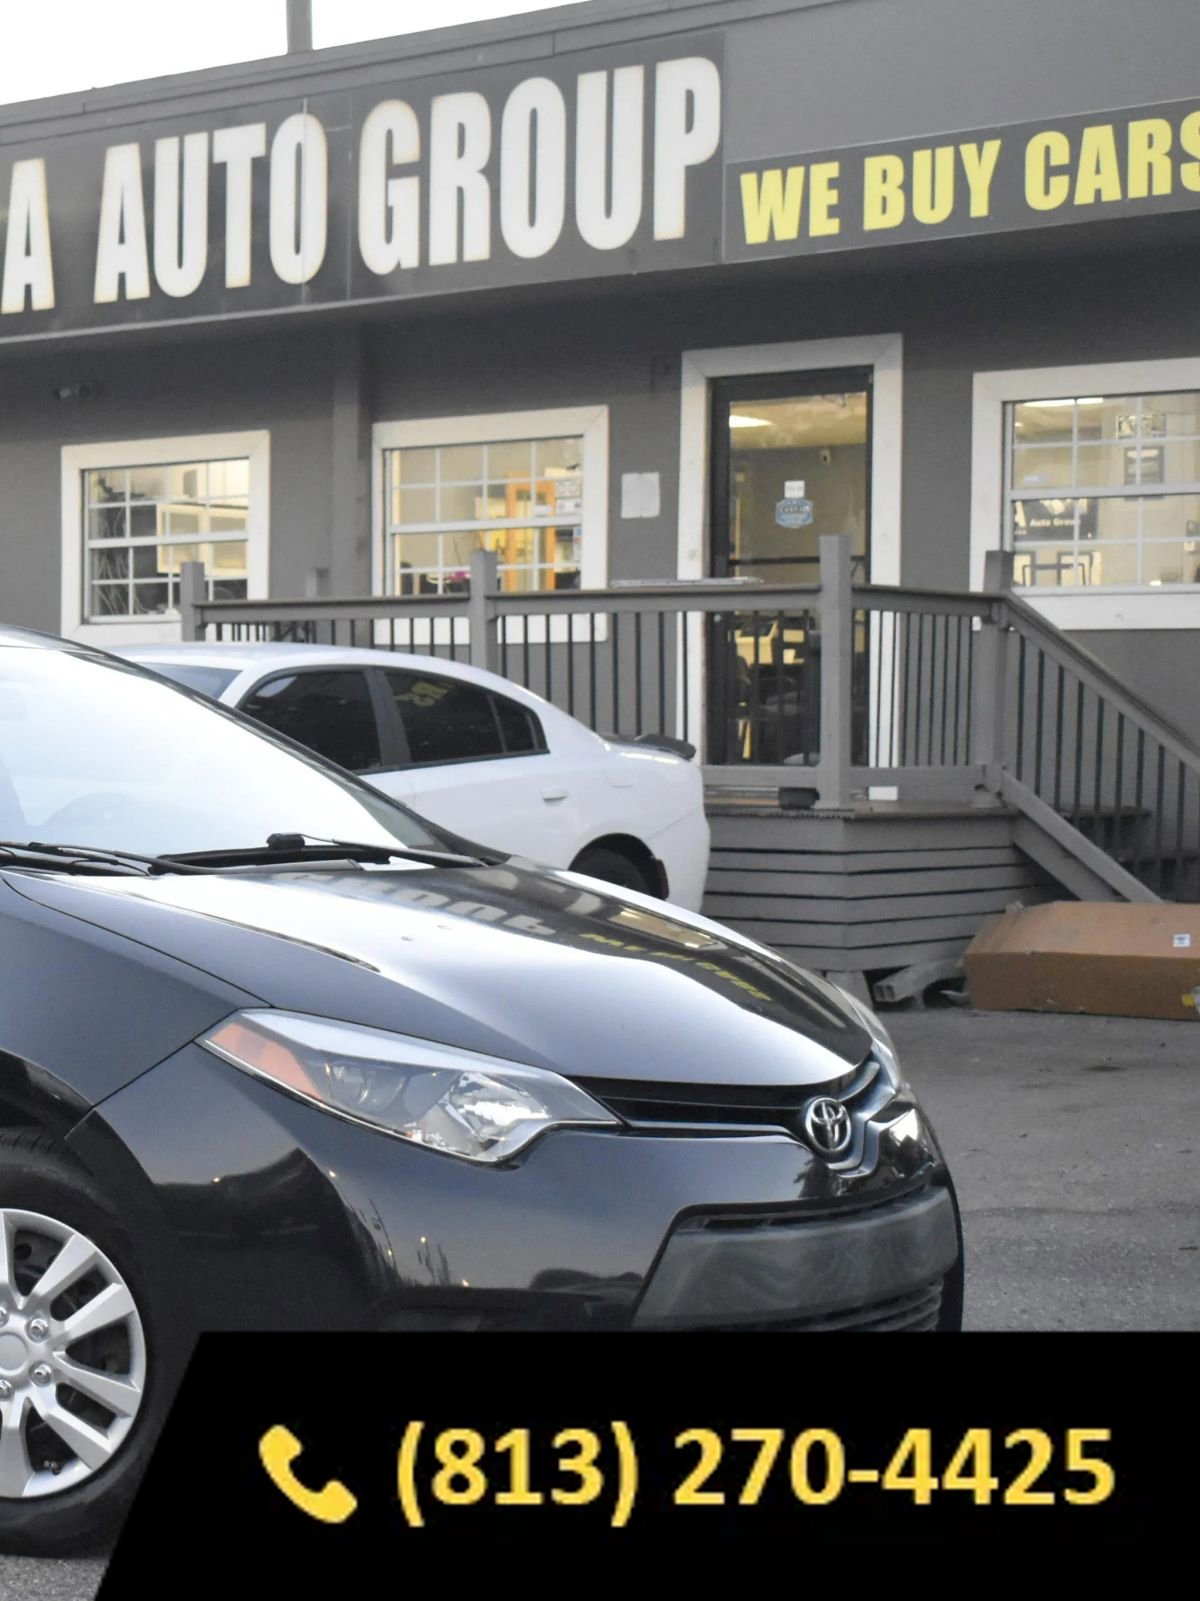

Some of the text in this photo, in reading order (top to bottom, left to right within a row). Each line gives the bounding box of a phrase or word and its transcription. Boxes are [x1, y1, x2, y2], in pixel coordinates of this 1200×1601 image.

[93, 112, 328, 303] AUTO
[358, 57, 721, 275] GROUP
[740, 163, 840, 244] WE
[863, 140, 1002, 231] BUY
[1053, 517, 1081, 528] Grou
